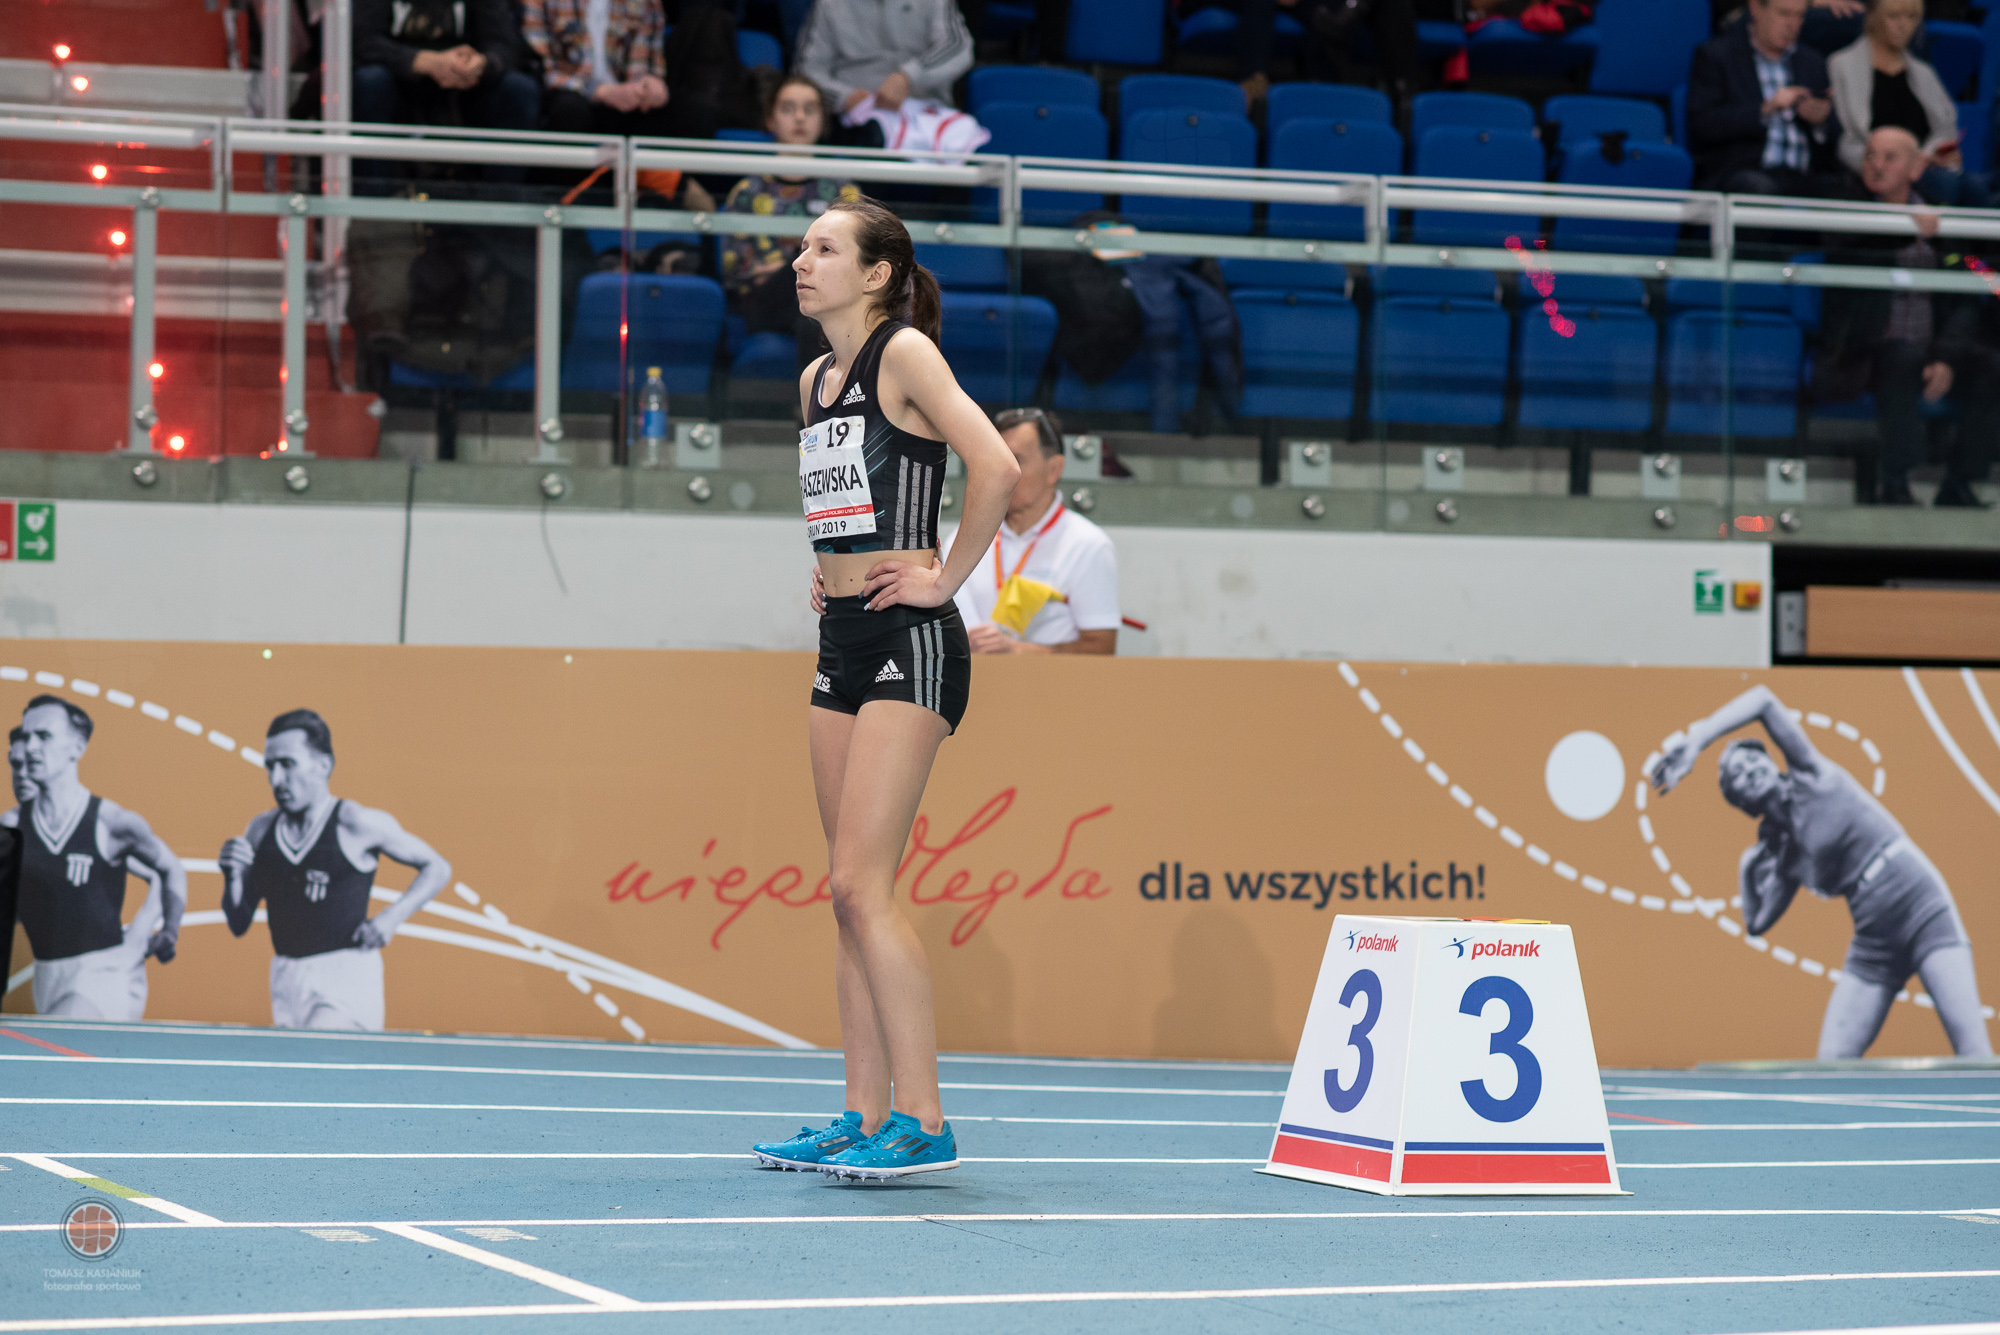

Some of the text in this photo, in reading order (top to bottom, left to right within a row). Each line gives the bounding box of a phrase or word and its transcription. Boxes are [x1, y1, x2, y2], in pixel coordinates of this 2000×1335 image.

[842, 393, 866, 406] adidas
[827, 421, 850, 448] 19
[822, 520, 847, 534] 2019
[875, 671, 905, 683] adidas
[1138, 861, 1210, 901] dla
[1224, 861, 1485, 910] wszystkich!
[1356, 933, 1399, 953] polanik
[1471, 939, 1541, 960] polanik
[1323, 968, 1383, 1113] 3
[1458, 975, 1543, 1123] 3
